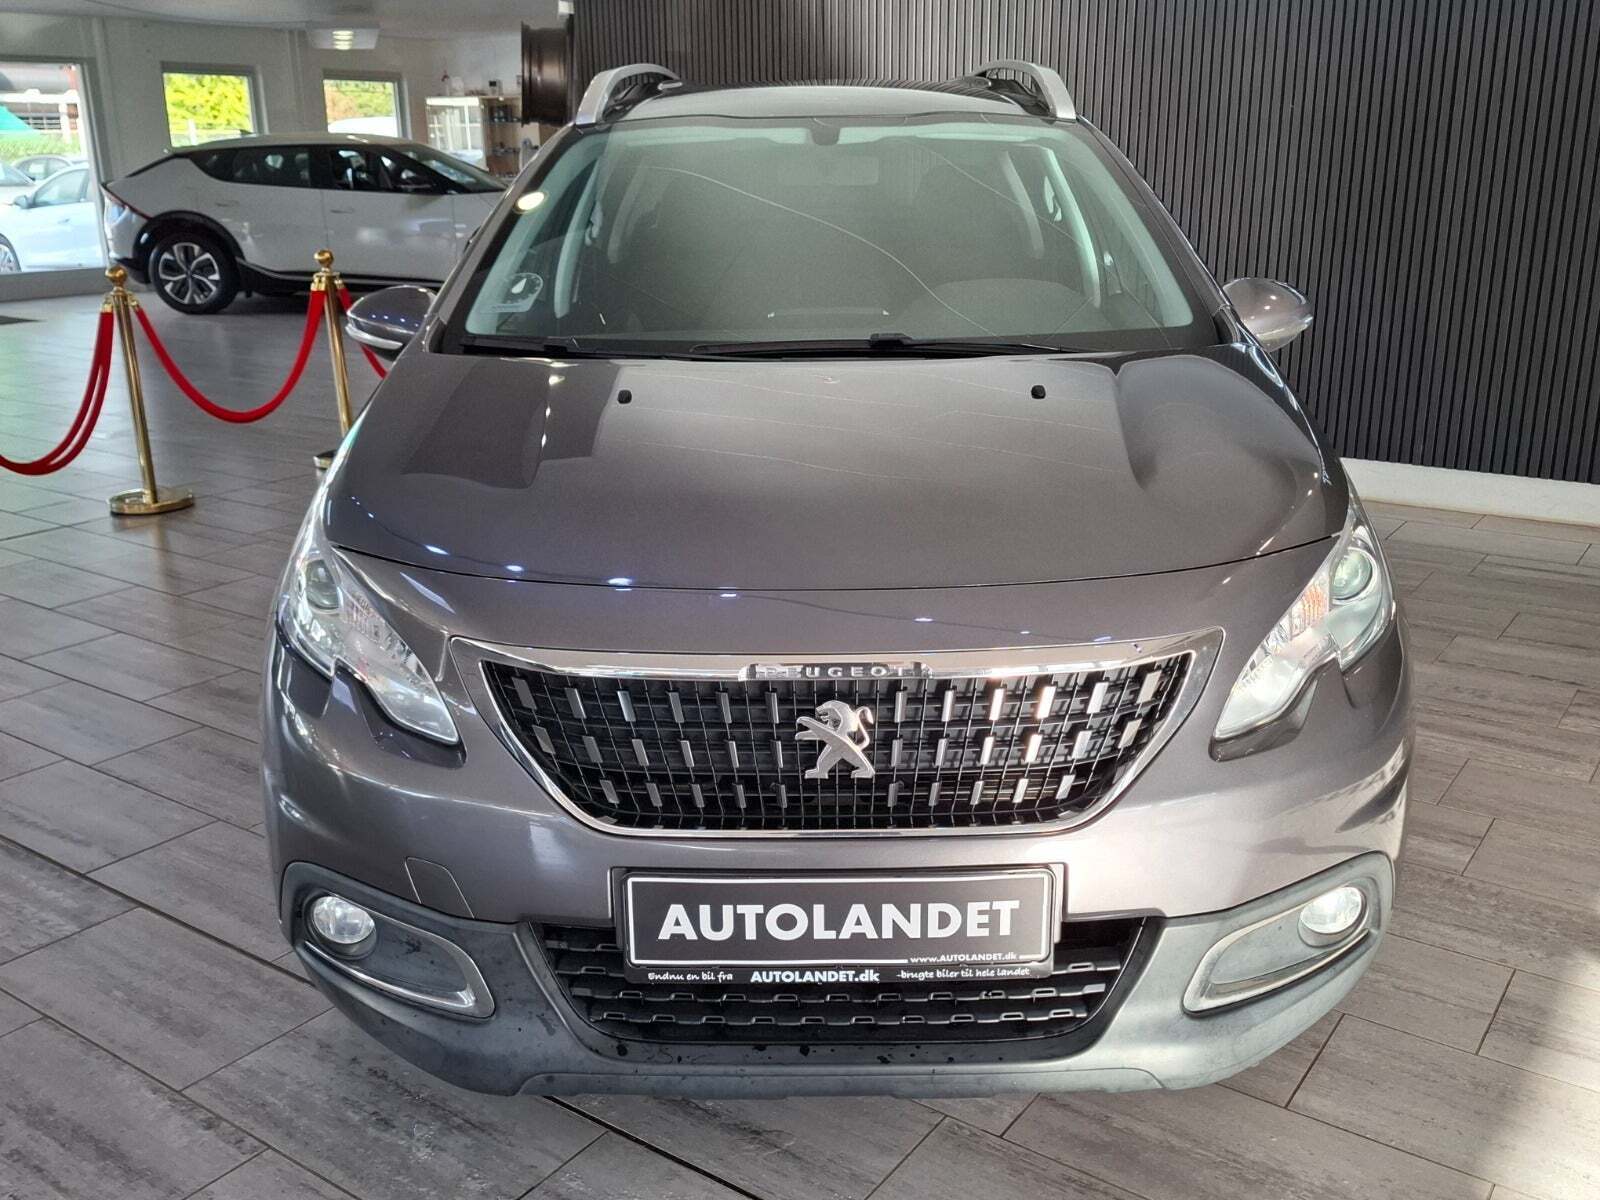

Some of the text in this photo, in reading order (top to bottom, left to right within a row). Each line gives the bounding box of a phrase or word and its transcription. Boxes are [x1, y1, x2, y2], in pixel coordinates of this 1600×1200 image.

[657, 900, 1020, 941] AUTOLANDET
[910, 952, 1017, 963] www.AUTOLANDET.dk
[647, 971, 684, 981] Endnu
[686, 973, 700, 981] en
[701, 971, 715, 980] bil
[717, 971, 733, 983] fra
[750, 969, 880, 983] AUTOLANDET.dk
[936, 968, 960, 978] biler
[960, 968, 974, 977] til
[975, 967, 996, 977] hele
[997, 967, 1030, 976] landet
